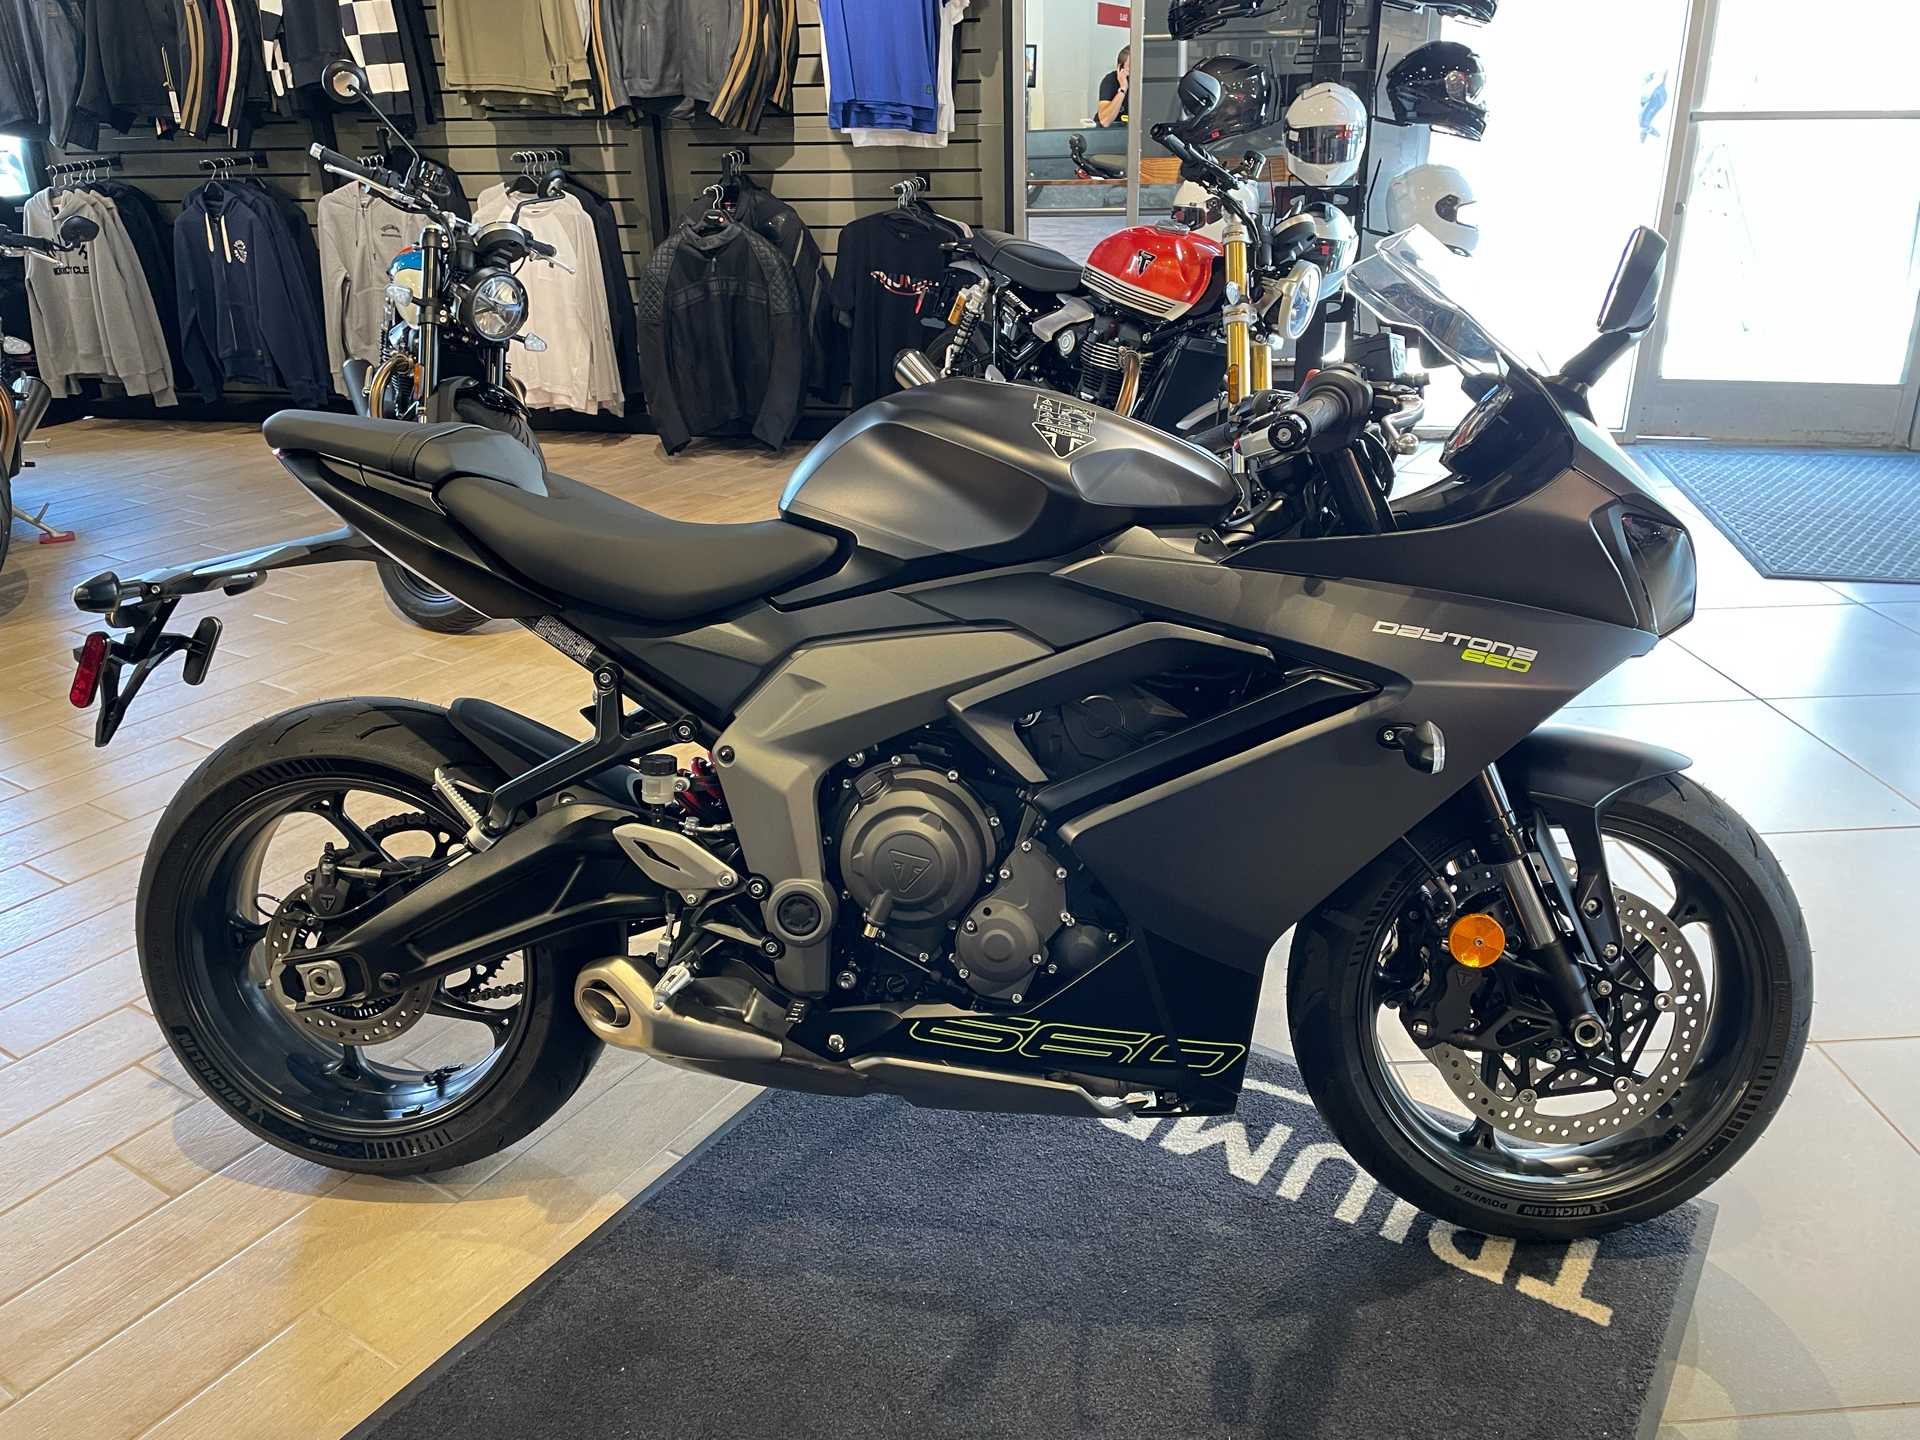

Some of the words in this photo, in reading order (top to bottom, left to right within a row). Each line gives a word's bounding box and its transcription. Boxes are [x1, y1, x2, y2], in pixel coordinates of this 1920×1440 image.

[1461, 648, 1532, 673] 660
[908, 1016, 1247, 1078] 660
[177, 1032, 249, 1108] MICHELIN
[1452, 1184, 1461, 1193] 6
[1462, 1189, 1509, 1210] POWER
[1523, 1203, 1591, 1217] MICHELIN
